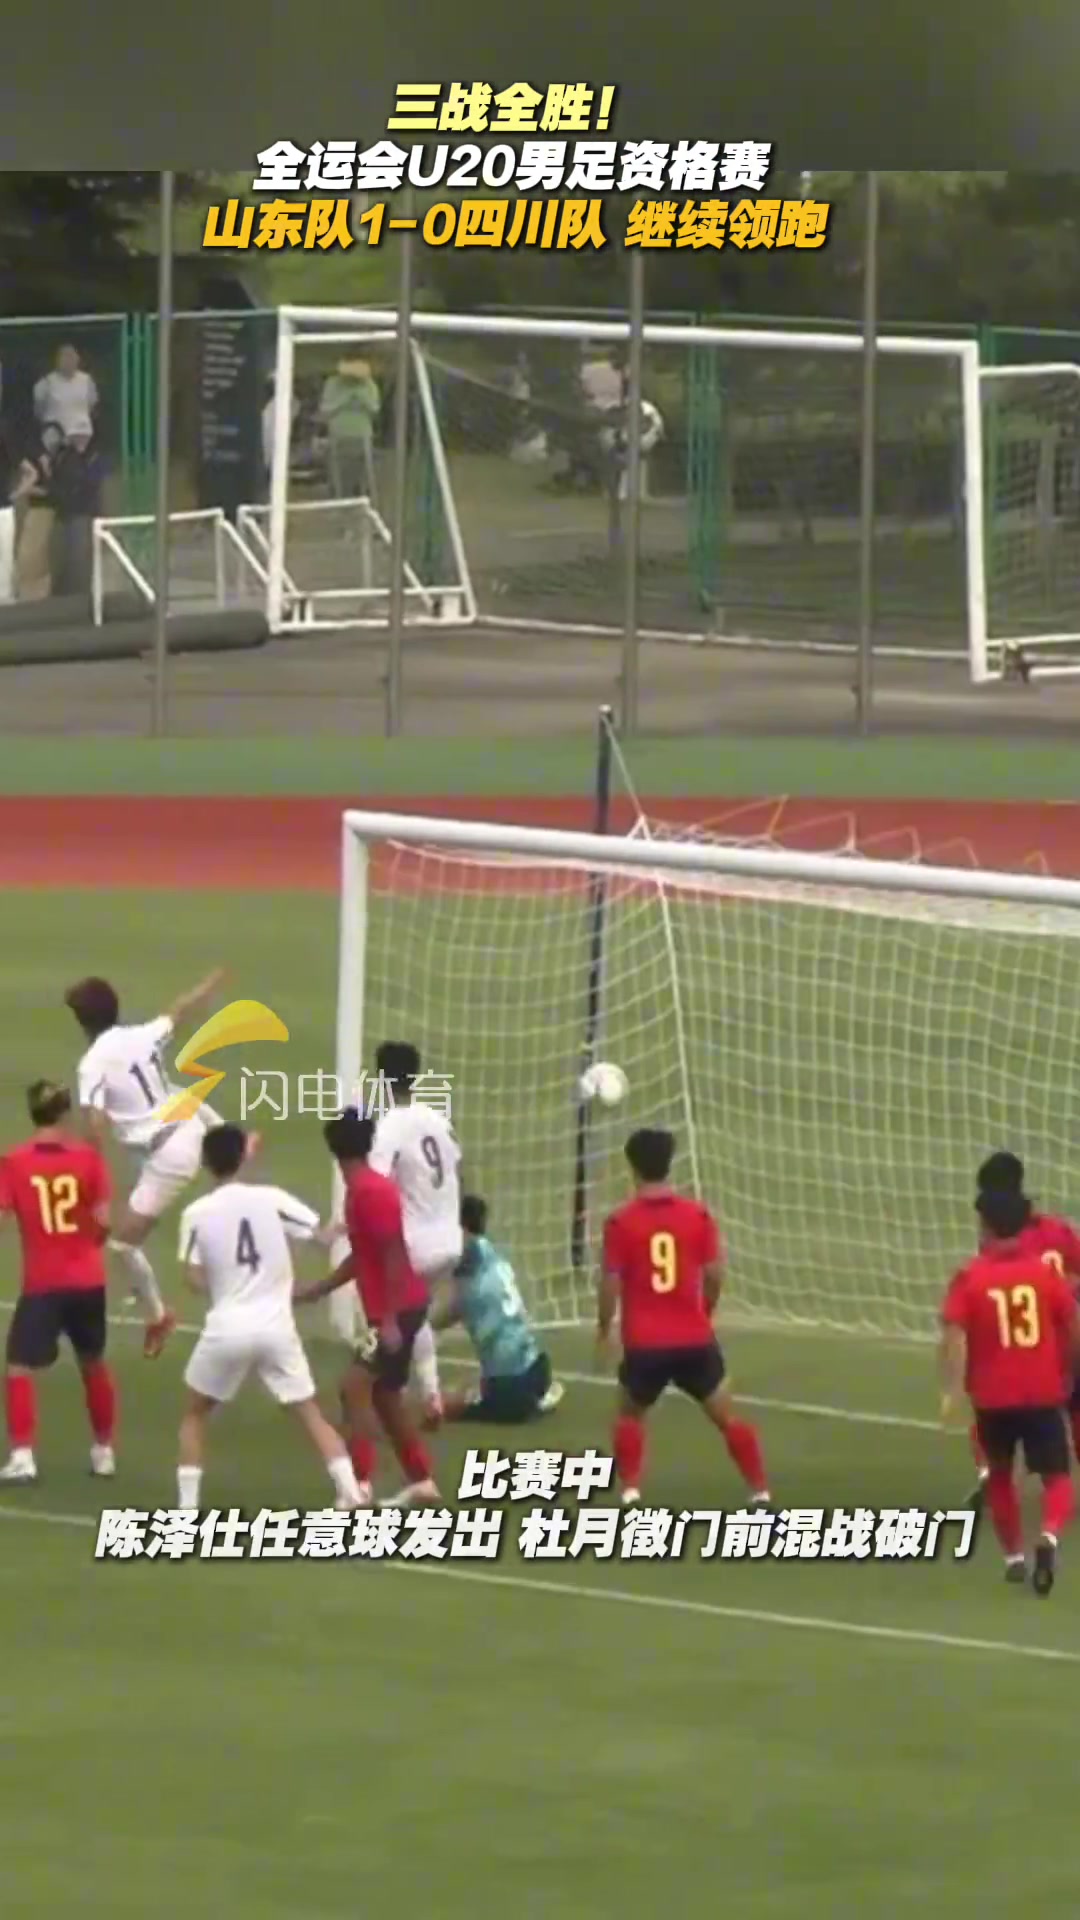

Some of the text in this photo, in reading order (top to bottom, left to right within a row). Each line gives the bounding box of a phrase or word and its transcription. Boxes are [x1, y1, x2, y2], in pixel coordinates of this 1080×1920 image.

[421, 1135, 445, 1191] 9
[31, 1174, 79, 1234] 12
[236, 1217, 261, 1274] 4
[649, 1231, 677, 1294] 9
[986, 1284, 1040, 1349] 13
